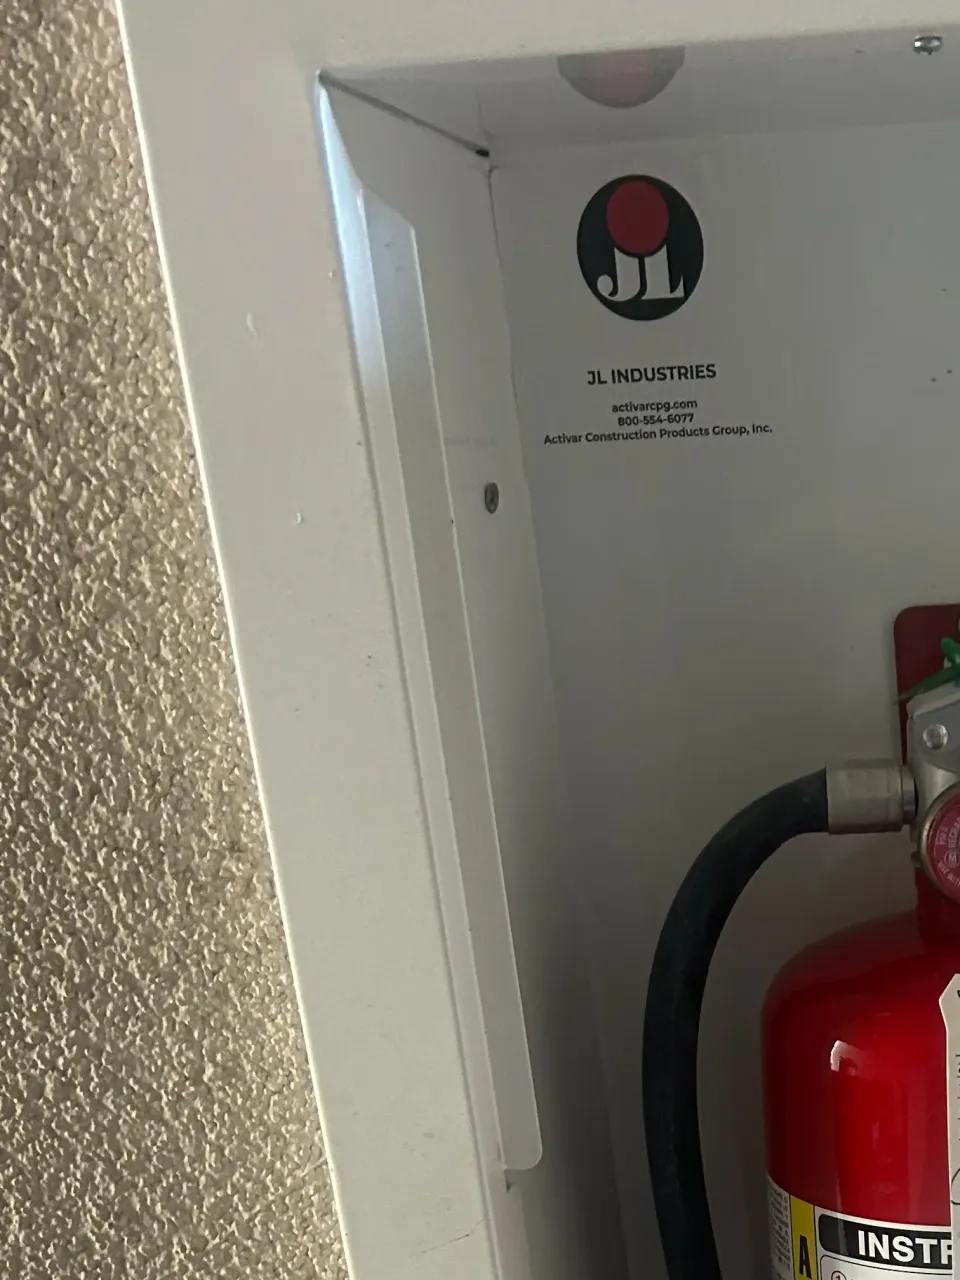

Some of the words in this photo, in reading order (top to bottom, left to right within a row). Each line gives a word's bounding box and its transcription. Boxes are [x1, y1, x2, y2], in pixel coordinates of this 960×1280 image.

[597, 243, 685, 302] JL
[587, 369, 608, 385] JL
[611, 363, 717, 384] INDUSTRIES
[611, 400, 698, 414] activarcpg.com
[617, 413, 694, 427] 800-554-6077
[543, 433, 583, 444] Activar
[585, 429, 657, 443] Construction
[659, 427, 710, 439] Products
[712, 424, 750, 436] Group,
[752, 423, 773, 434] Inc.
[799, 1234, 813, 1280] A
